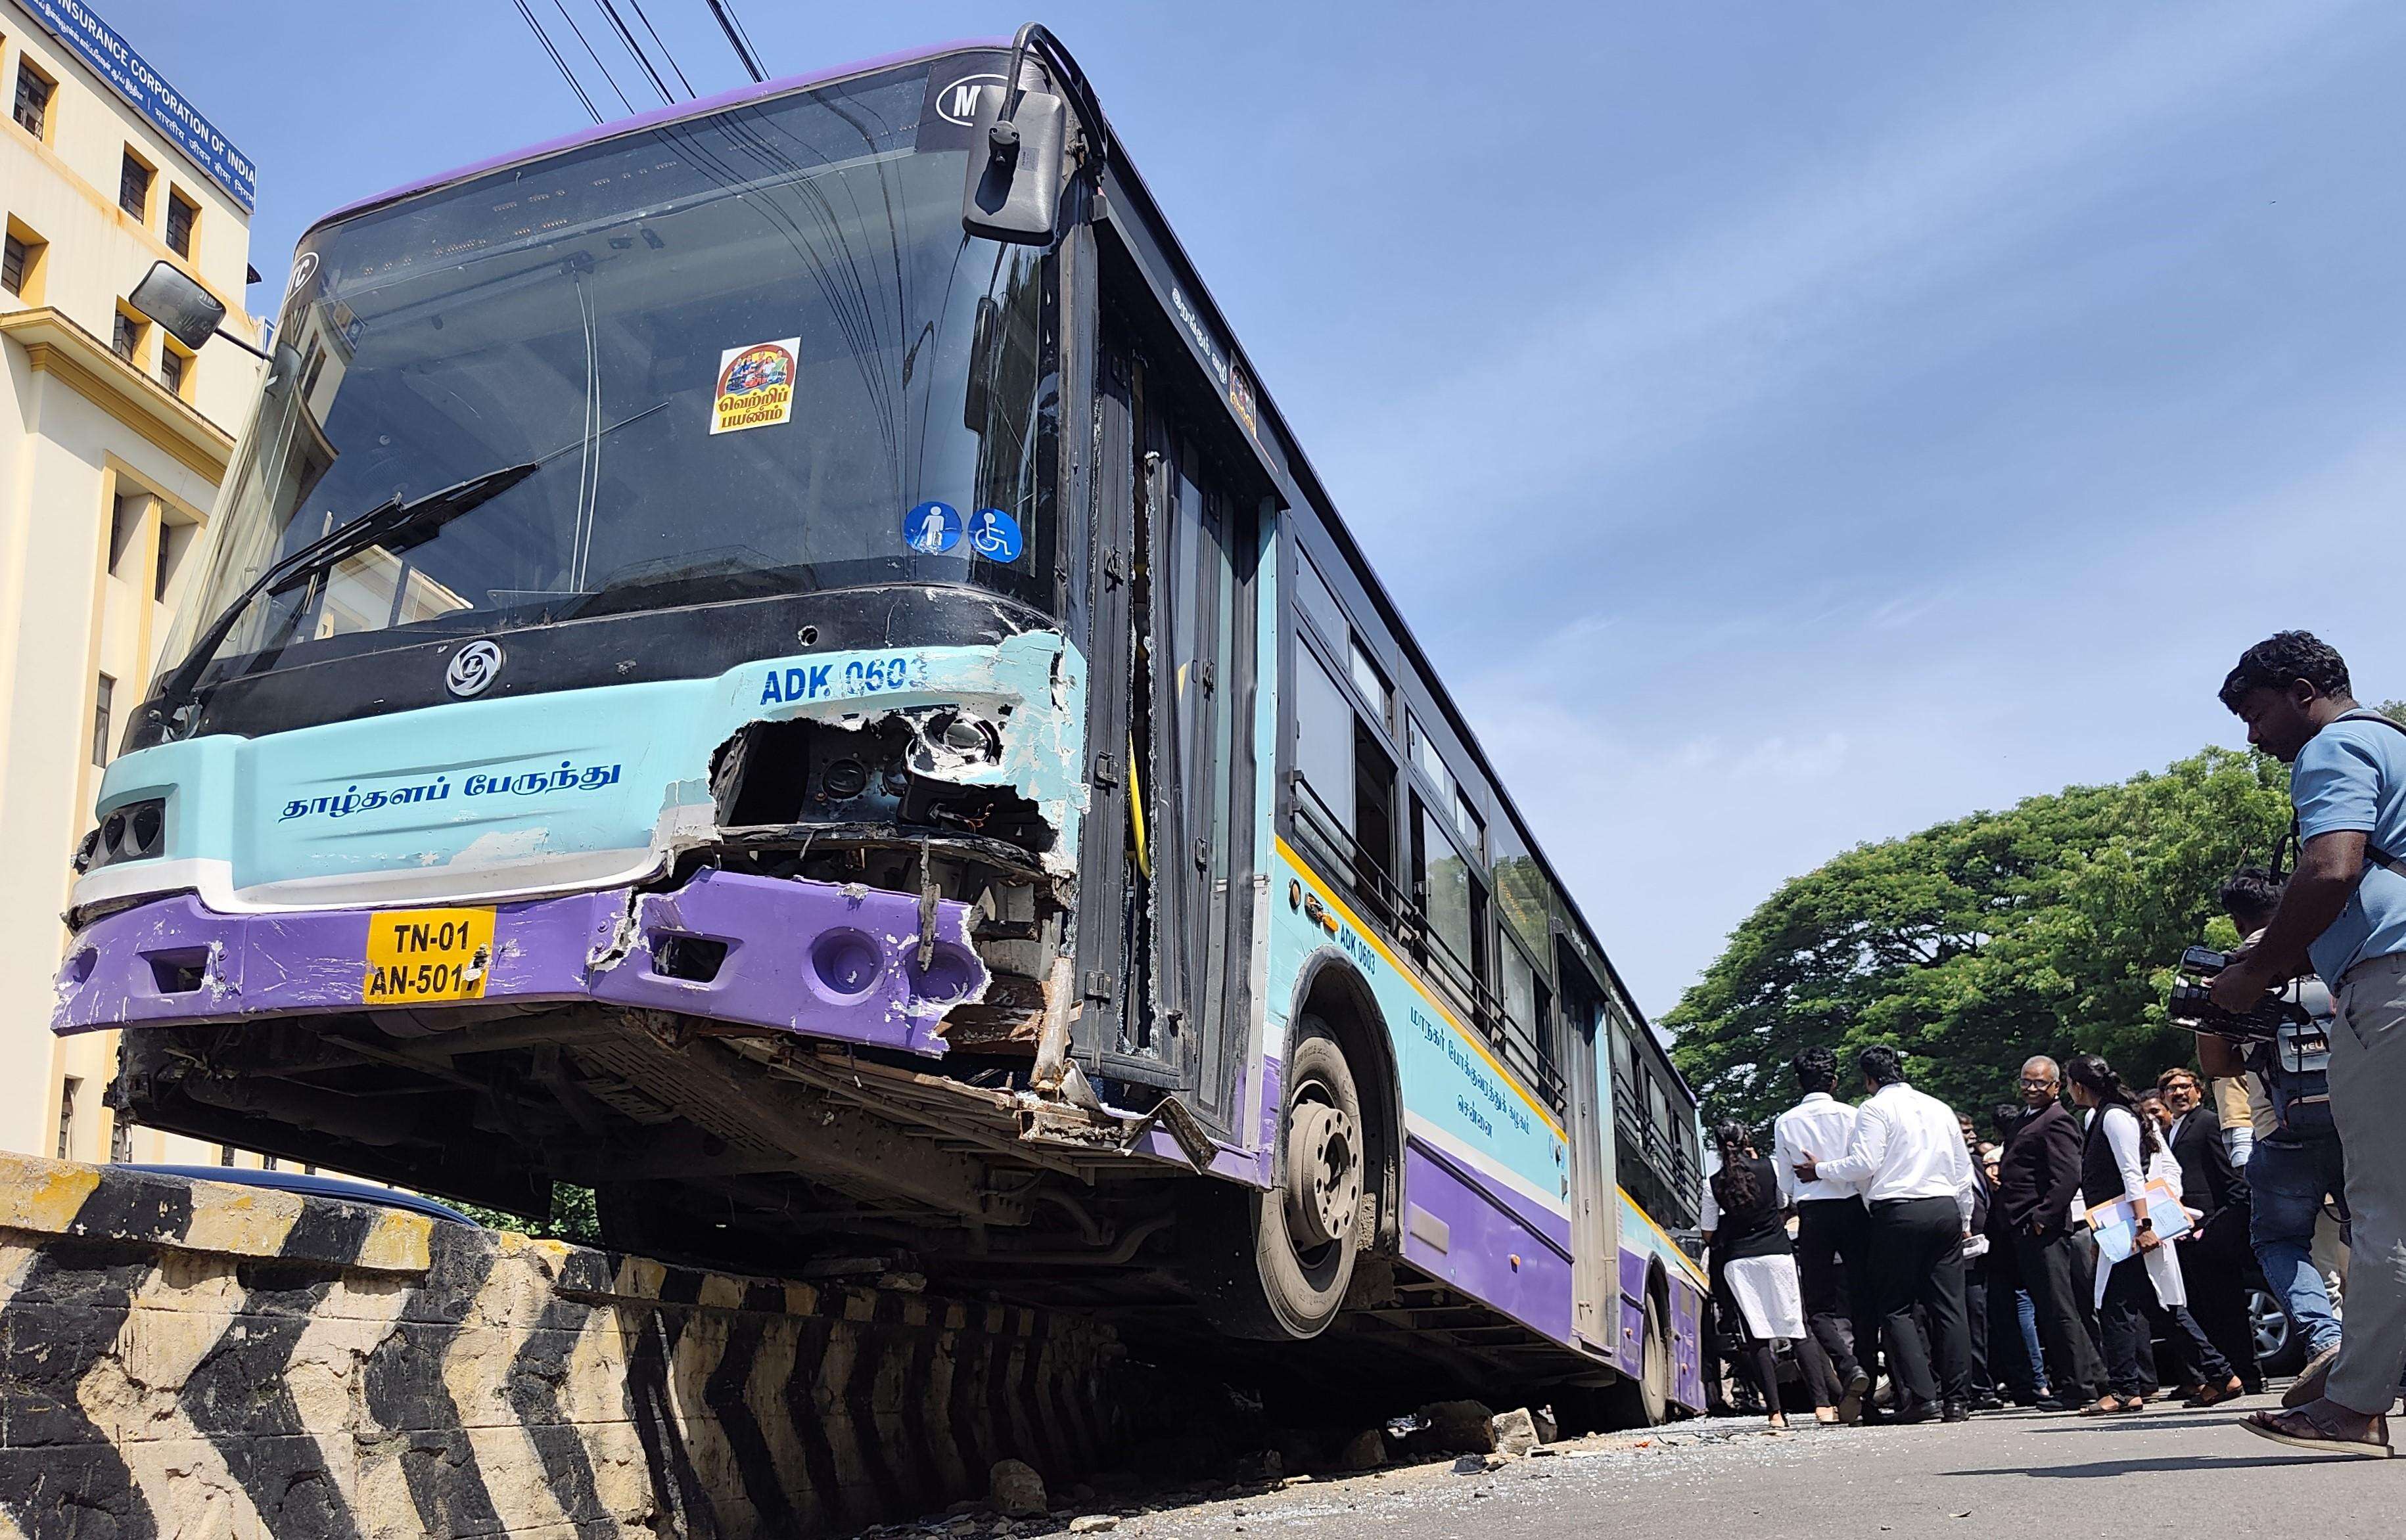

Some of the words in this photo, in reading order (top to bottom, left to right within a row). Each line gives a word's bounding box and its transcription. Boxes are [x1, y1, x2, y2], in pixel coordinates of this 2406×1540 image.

[58, 0, 129, 66] NSURANCE
[131, 59, 209, 143] CORPORATION
[212, 135, 225, 156] OF
[227, 149, 255, 187] INDIA
[125, 78, 143, 101] இந்தியா
[154, 107, 185, 141] भारतीय
[188, 138, 211, 165] जीवन
[214, 162, 231, 184] बीमा
[234, 179, 254, 206] निगम
[1172, 288, 1211, 356] இறங்கும்
[1211, 353, 1227, 384] வழி
[719, 387, 789, 413] வெற்றிப்
[722, 405, 783, 428] பயணம்
[760, 664, 834, 705] ADK
[278, 775, 451, 824] தாழ்தளப்
[464, 760, 622, 796] பேருந்து
[394, 920, 469, 953] TN-01
[1340, 924, 1356, 957] ADK
[1358, 941, 1375, 976] 0603
[2290, 1039, 2324, 1051] LveU
[1410, 1006, 1445, 1052] மாநகர்
[1448, 1039, 1507, 1114] போக்குவரத்துக்
[1509, 1105, 1530, 1135] கழகம்
[1457, 1094, 1492, 1138] சென்னை
